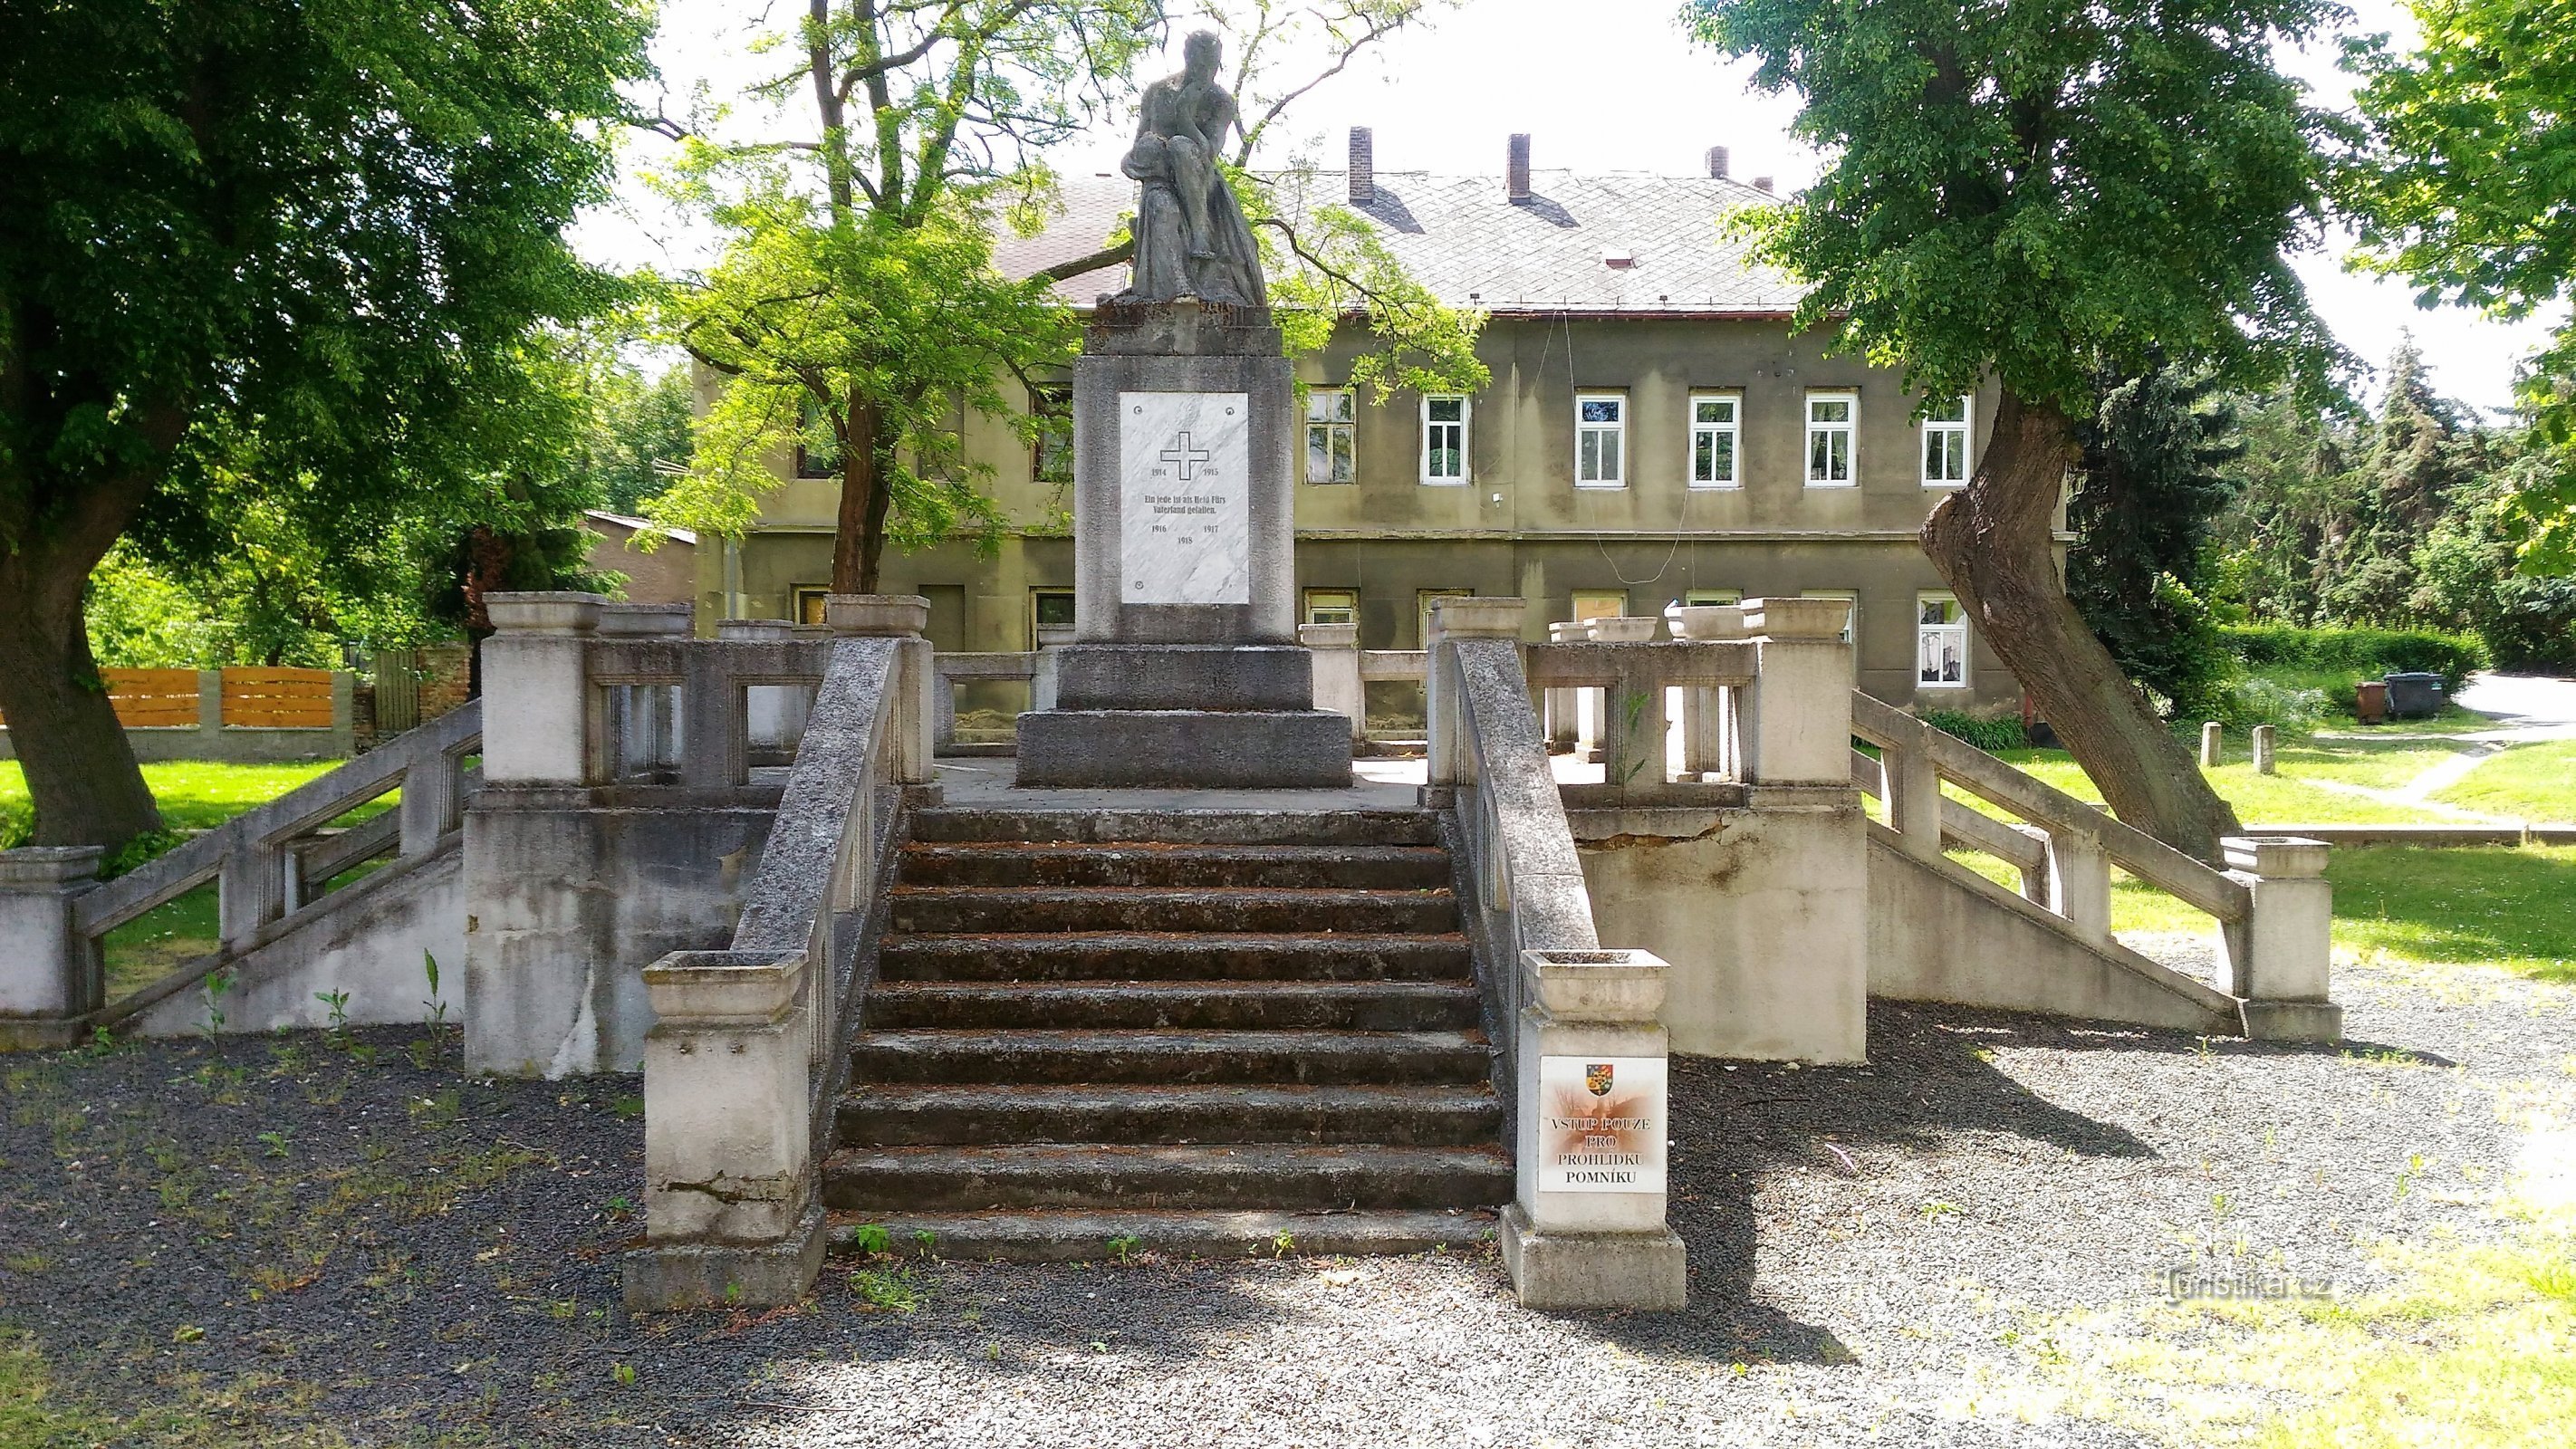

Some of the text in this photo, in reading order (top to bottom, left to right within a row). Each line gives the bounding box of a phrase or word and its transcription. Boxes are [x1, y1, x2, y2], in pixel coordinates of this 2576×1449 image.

[1152, 468, 1167, 476] 1914
[1203, 468, 1219, 476] 1915
[1144, 495, 1156, 504] Ein
[1157, 495, 1172, 504] jede
[1173, 495, 1181, 504] ist
[1182, 495, 1193, 504] als
[1194, 495, 1210, 504] Held
[1187, 506, 1217, 514] gefallen.
[1177, 536, 1193, 544] 1918
[1551, 1118, 1650, 1130] VSTUP POUZE
[1585, 1136, 1617, 1147] PRO
[1557, 1150, 1645, 1166] PROHLÍDKU
[1565, 1168, 1637, 1184] POMNÍKU
